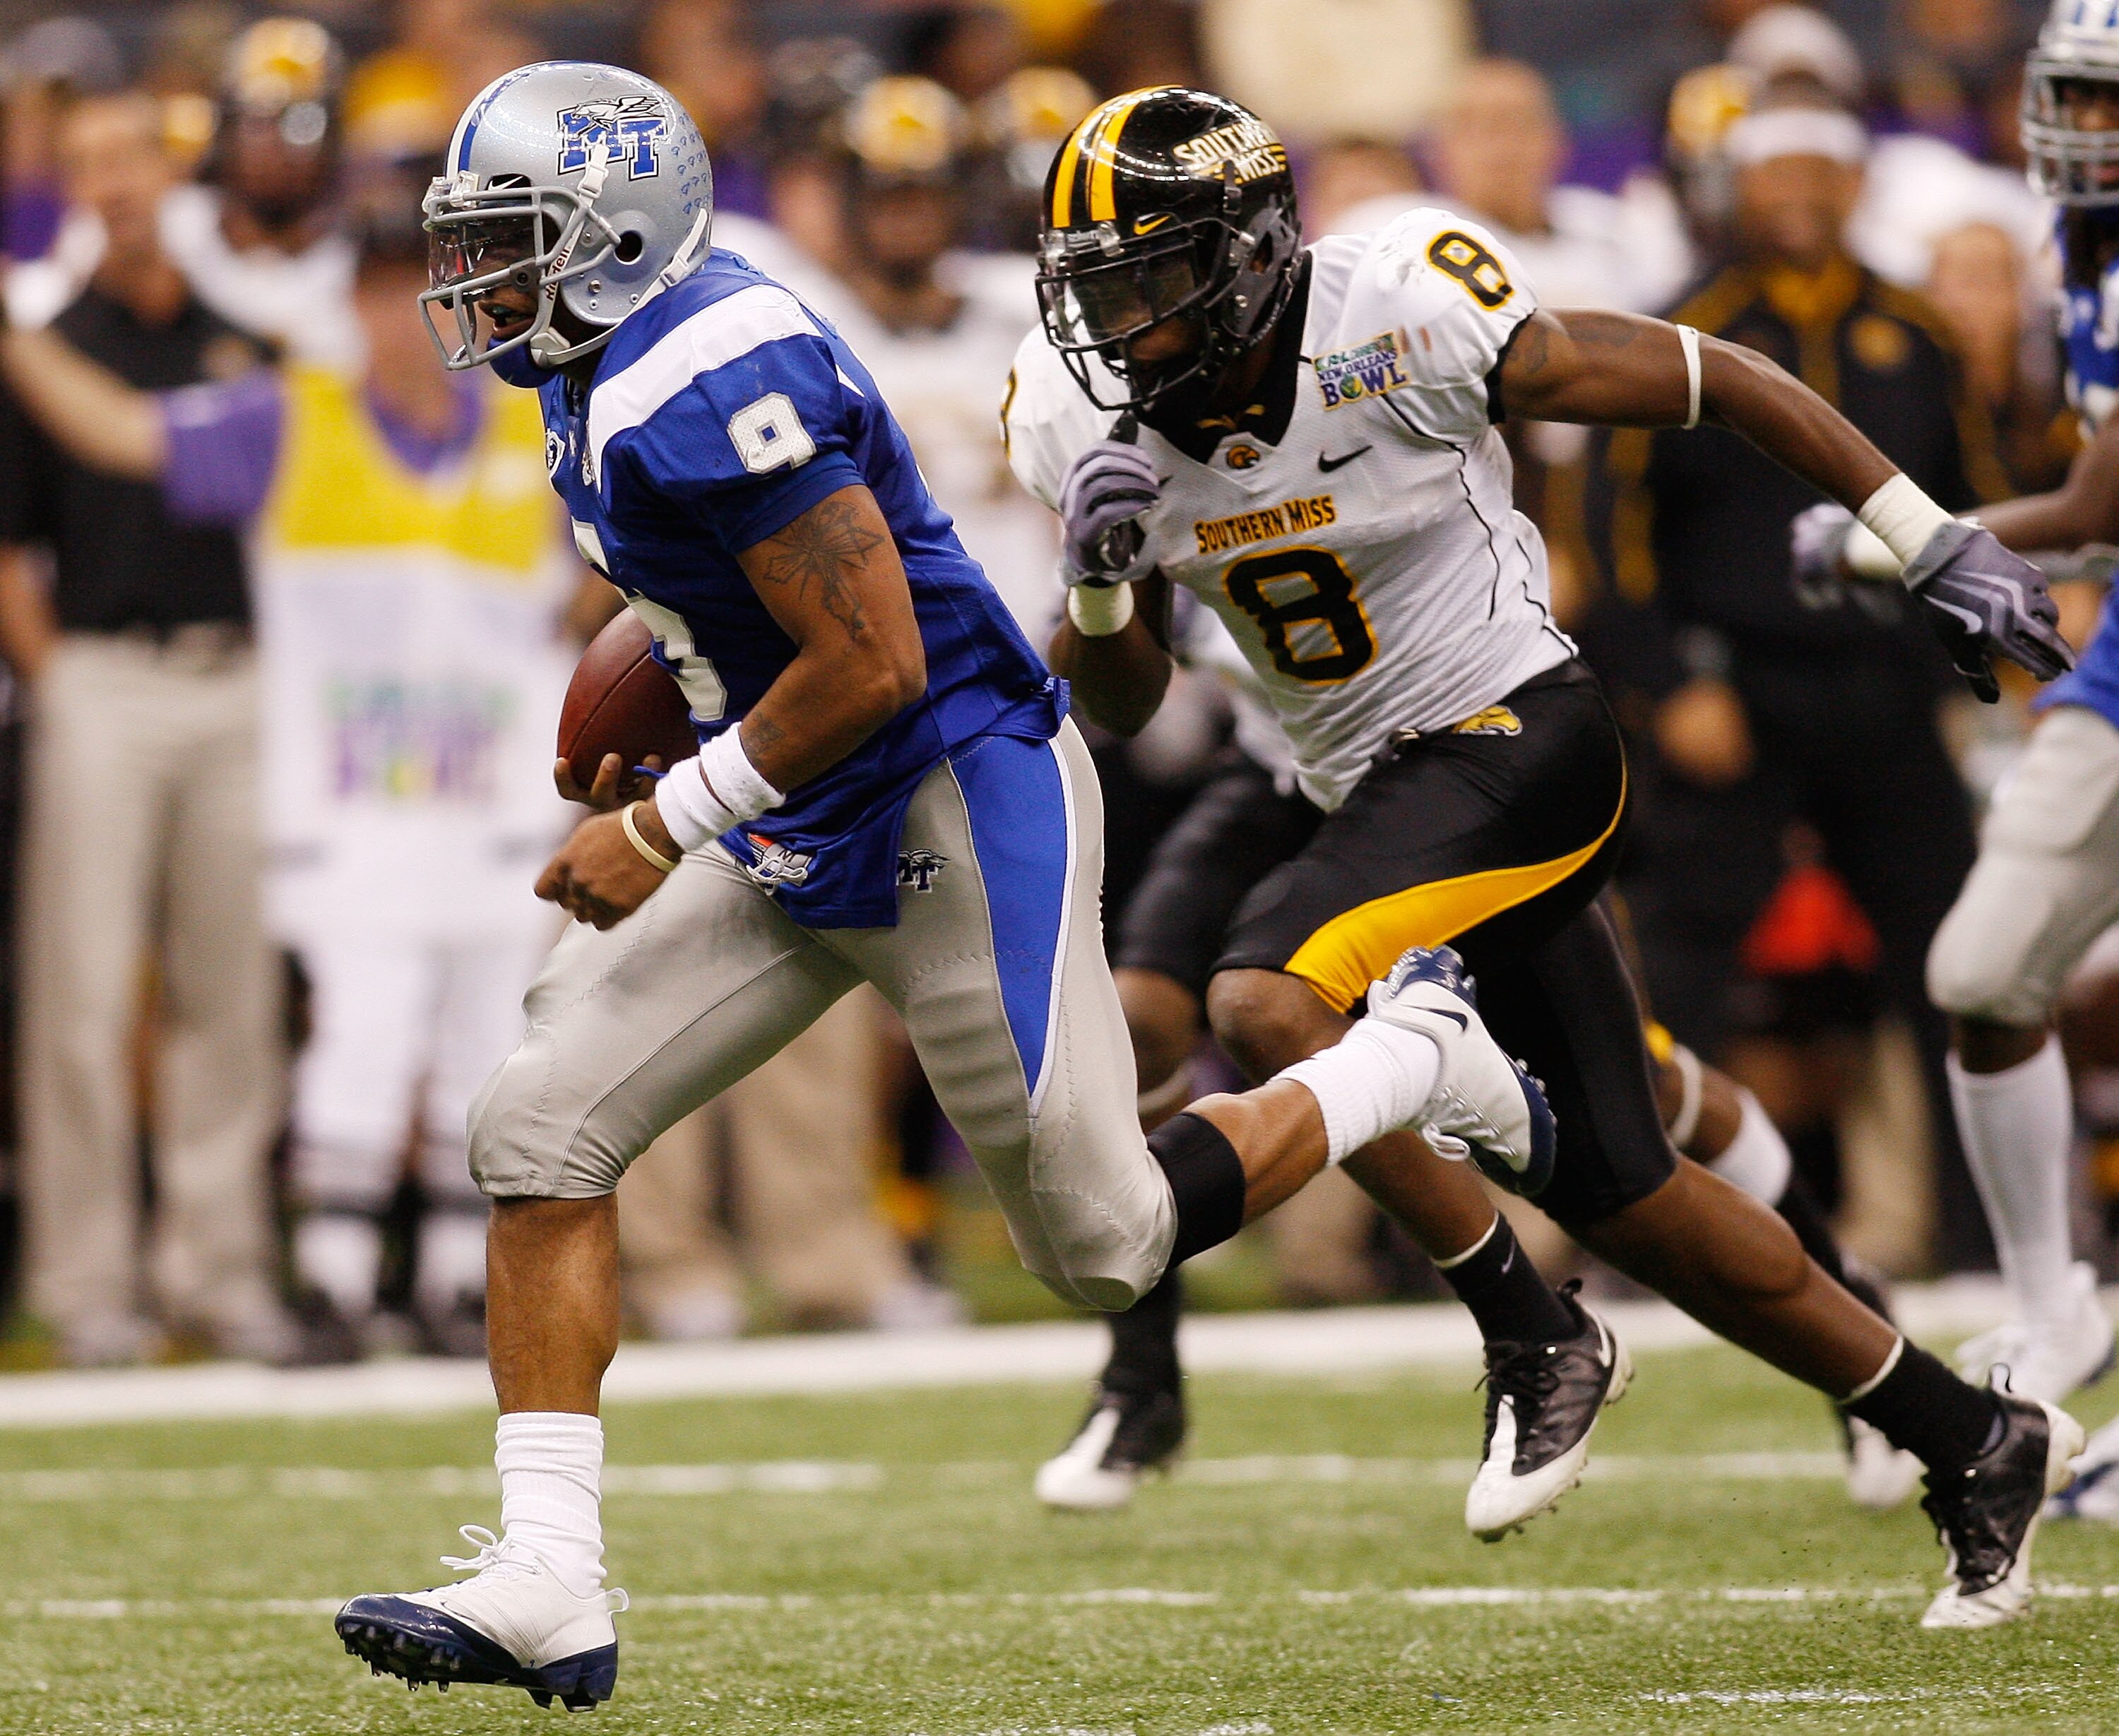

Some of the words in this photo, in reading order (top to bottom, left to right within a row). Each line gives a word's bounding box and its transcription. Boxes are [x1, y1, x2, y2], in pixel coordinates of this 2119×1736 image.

[1425, 230, 1515, 311] 8
[1321, 362, 1406, 408] BOWL
[727, 391, 817, 474] 9
[1194, 506, 1286, 556] SOUTHERN
[1282, 495, 1336, 533] MISS
[1223, 544, 1379, 686] 8
